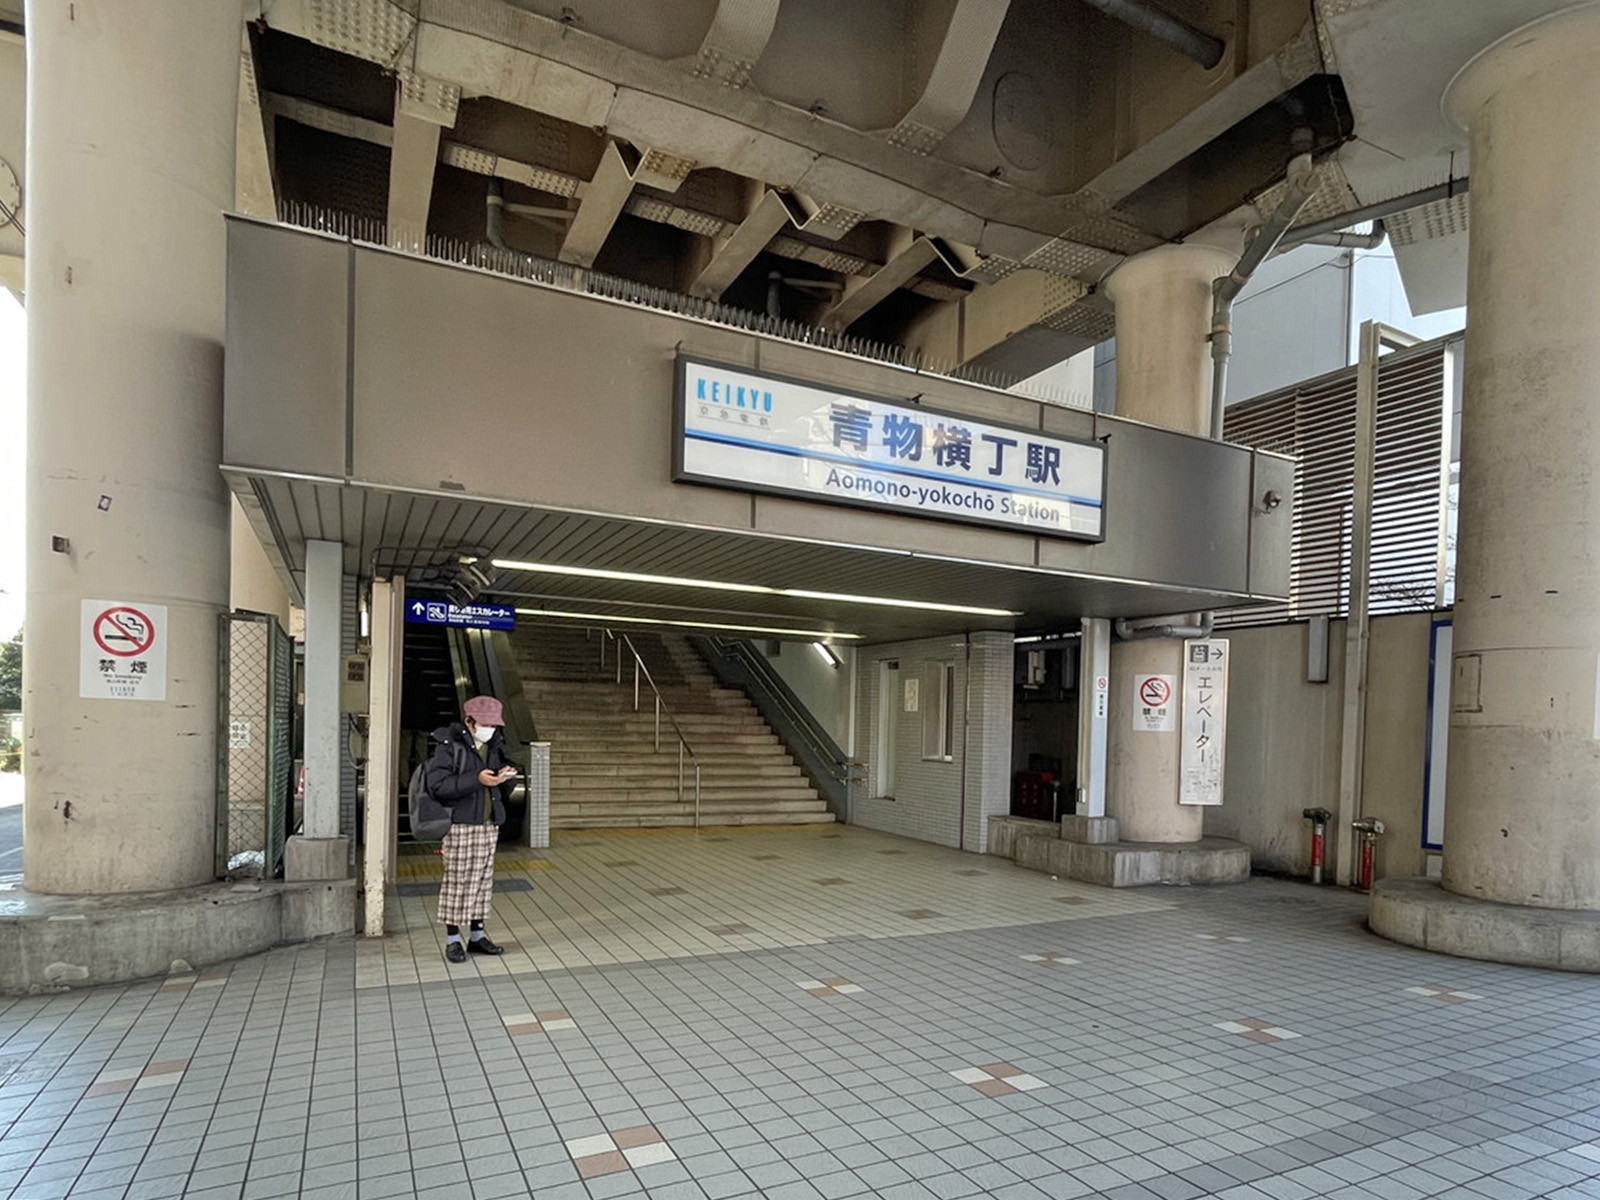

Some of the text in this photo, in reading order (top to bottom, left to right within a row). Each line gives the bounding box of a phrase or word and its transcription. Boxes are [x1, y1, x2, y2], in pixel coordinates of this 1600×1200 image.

[697, 378, 772, 412] KEIKYU
[829, 402, 1061, 486] 青物横丁駅
[826, 468, 1060, 522] Aomono-yokochō Station
[99, 659, 148, 674] 禁煙
[1196, 676, 1213, 762] エレベーター
